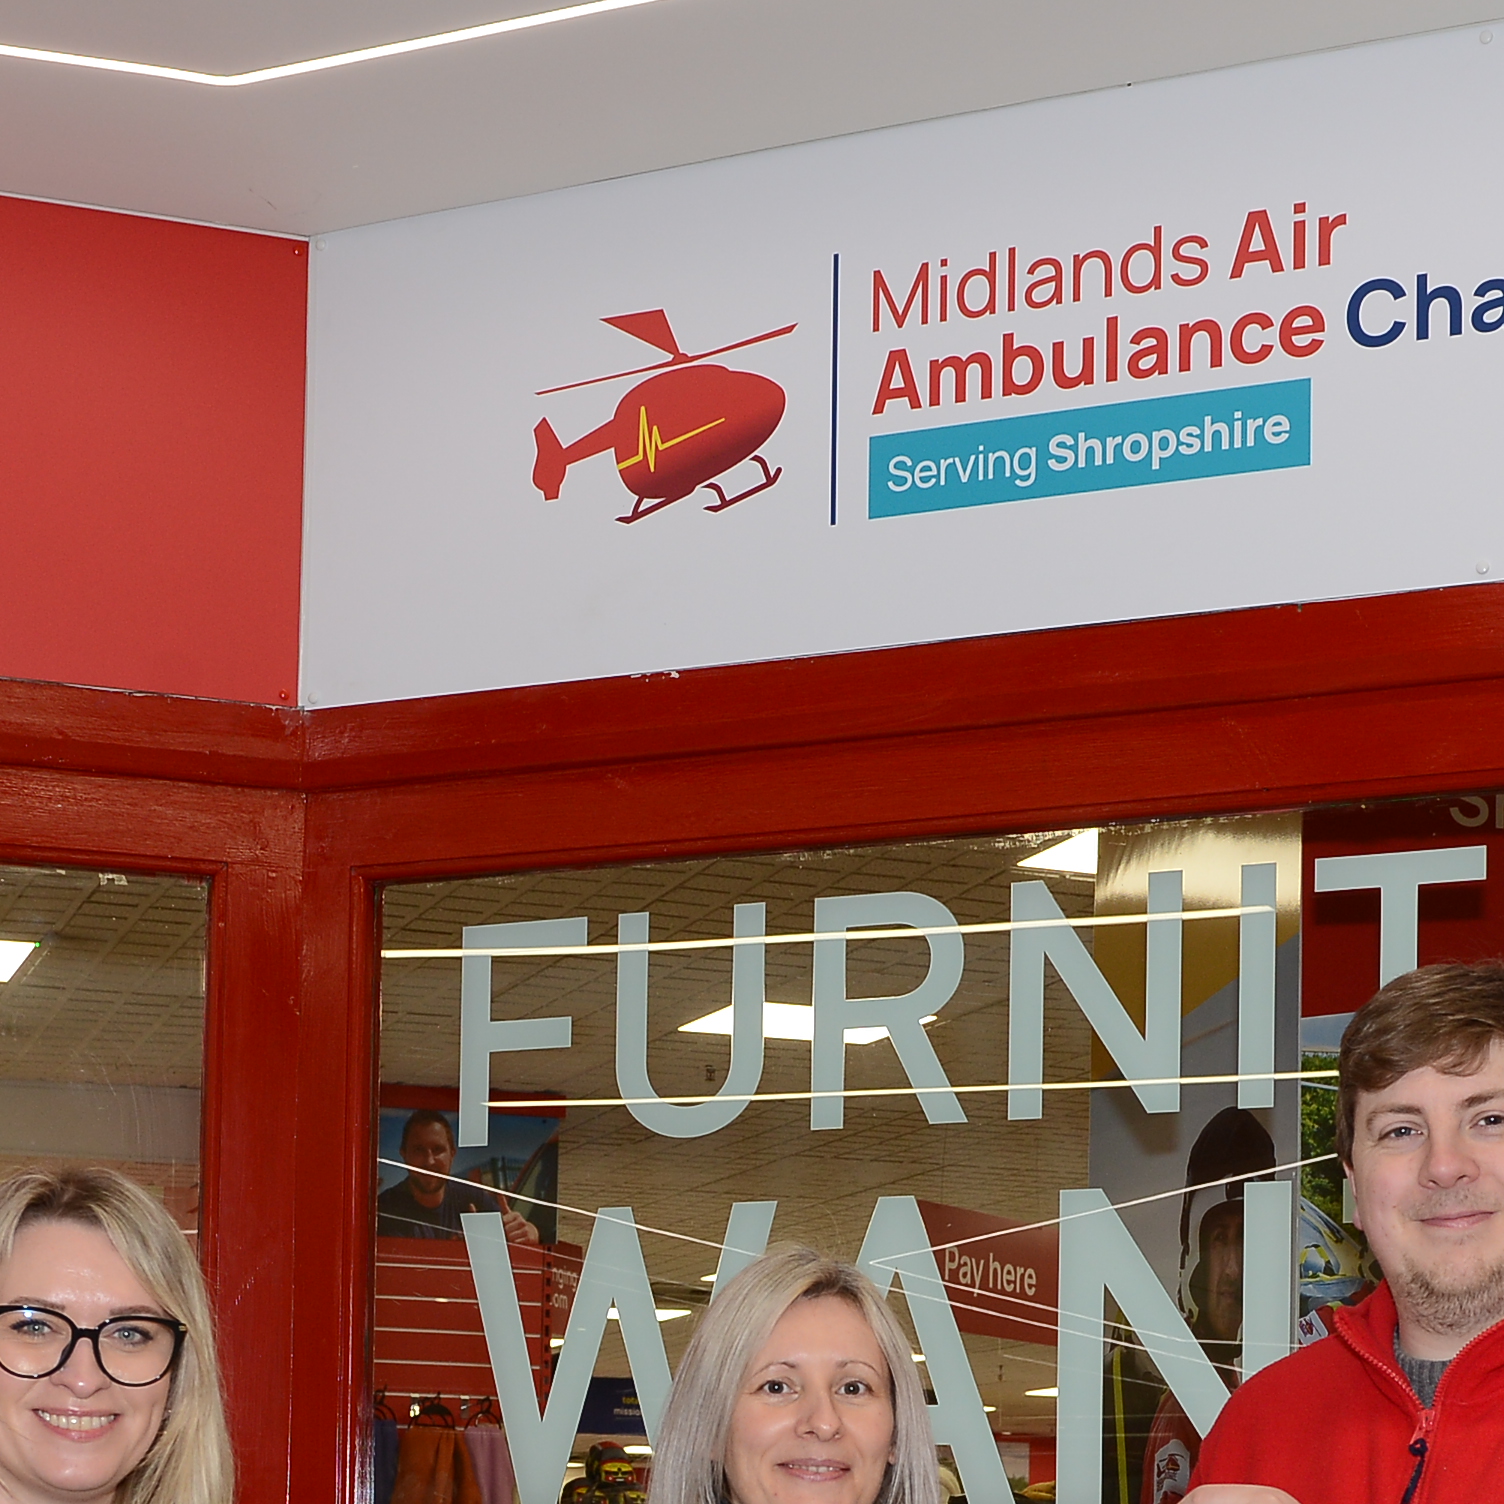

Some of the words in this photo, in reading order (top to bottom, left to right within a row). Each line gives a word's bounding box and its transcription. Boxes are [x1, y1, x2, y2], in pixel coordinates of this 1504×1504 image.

[871, 225, 1210, 334] Midlands
[1229, 202, 1347, 281] Air
[870, 305, 1326, 416] Ambulance
[887, 440, 1037, 494] Serving
[1046, 410, 1290, 477] Shropshire
[944, 1246, 985, 1297] Pay
[988, 1252, 1037, 1296] here
